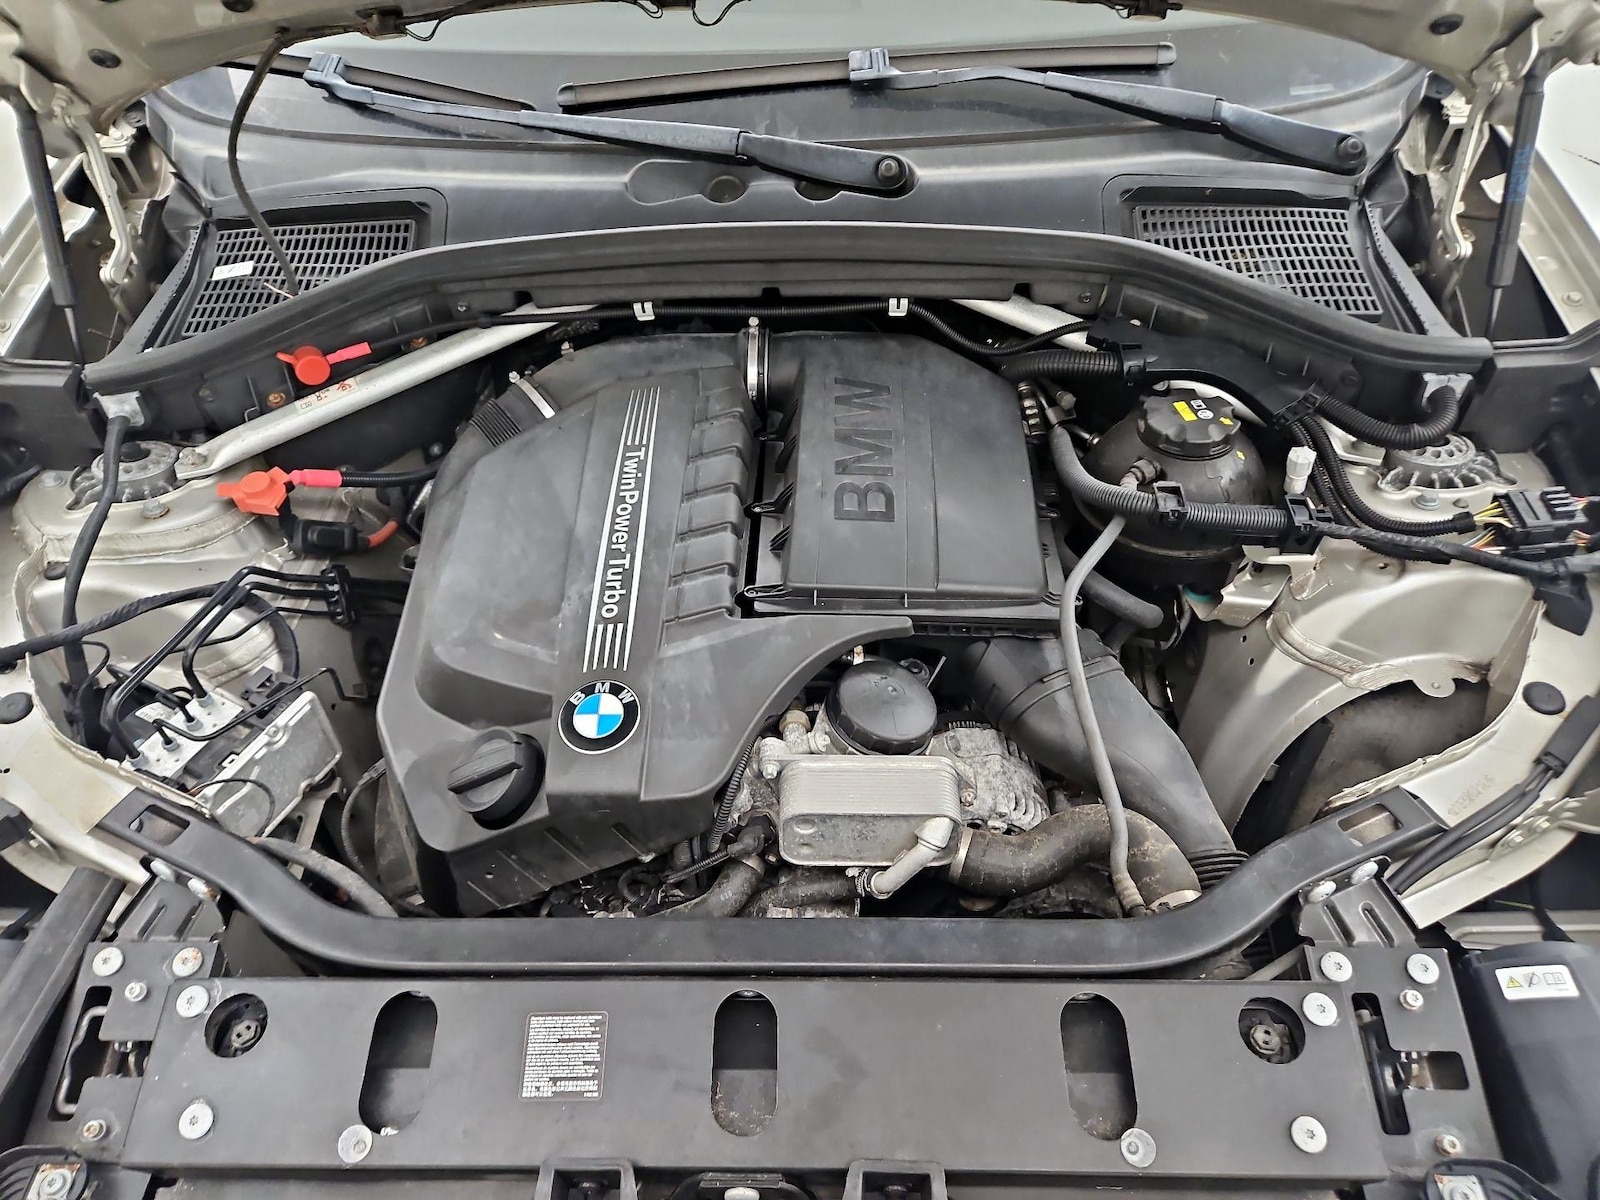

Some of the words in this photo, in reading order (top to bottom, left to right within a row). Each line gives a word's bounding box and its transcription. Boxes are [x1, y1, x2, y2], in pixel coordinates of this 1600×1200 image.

[834, 377, 895, 522] BMW
[611, 447, 645, 553] TwinPower
[601, 553, 631, 619] Turbo
[569, 682, 635, 706] BMW
